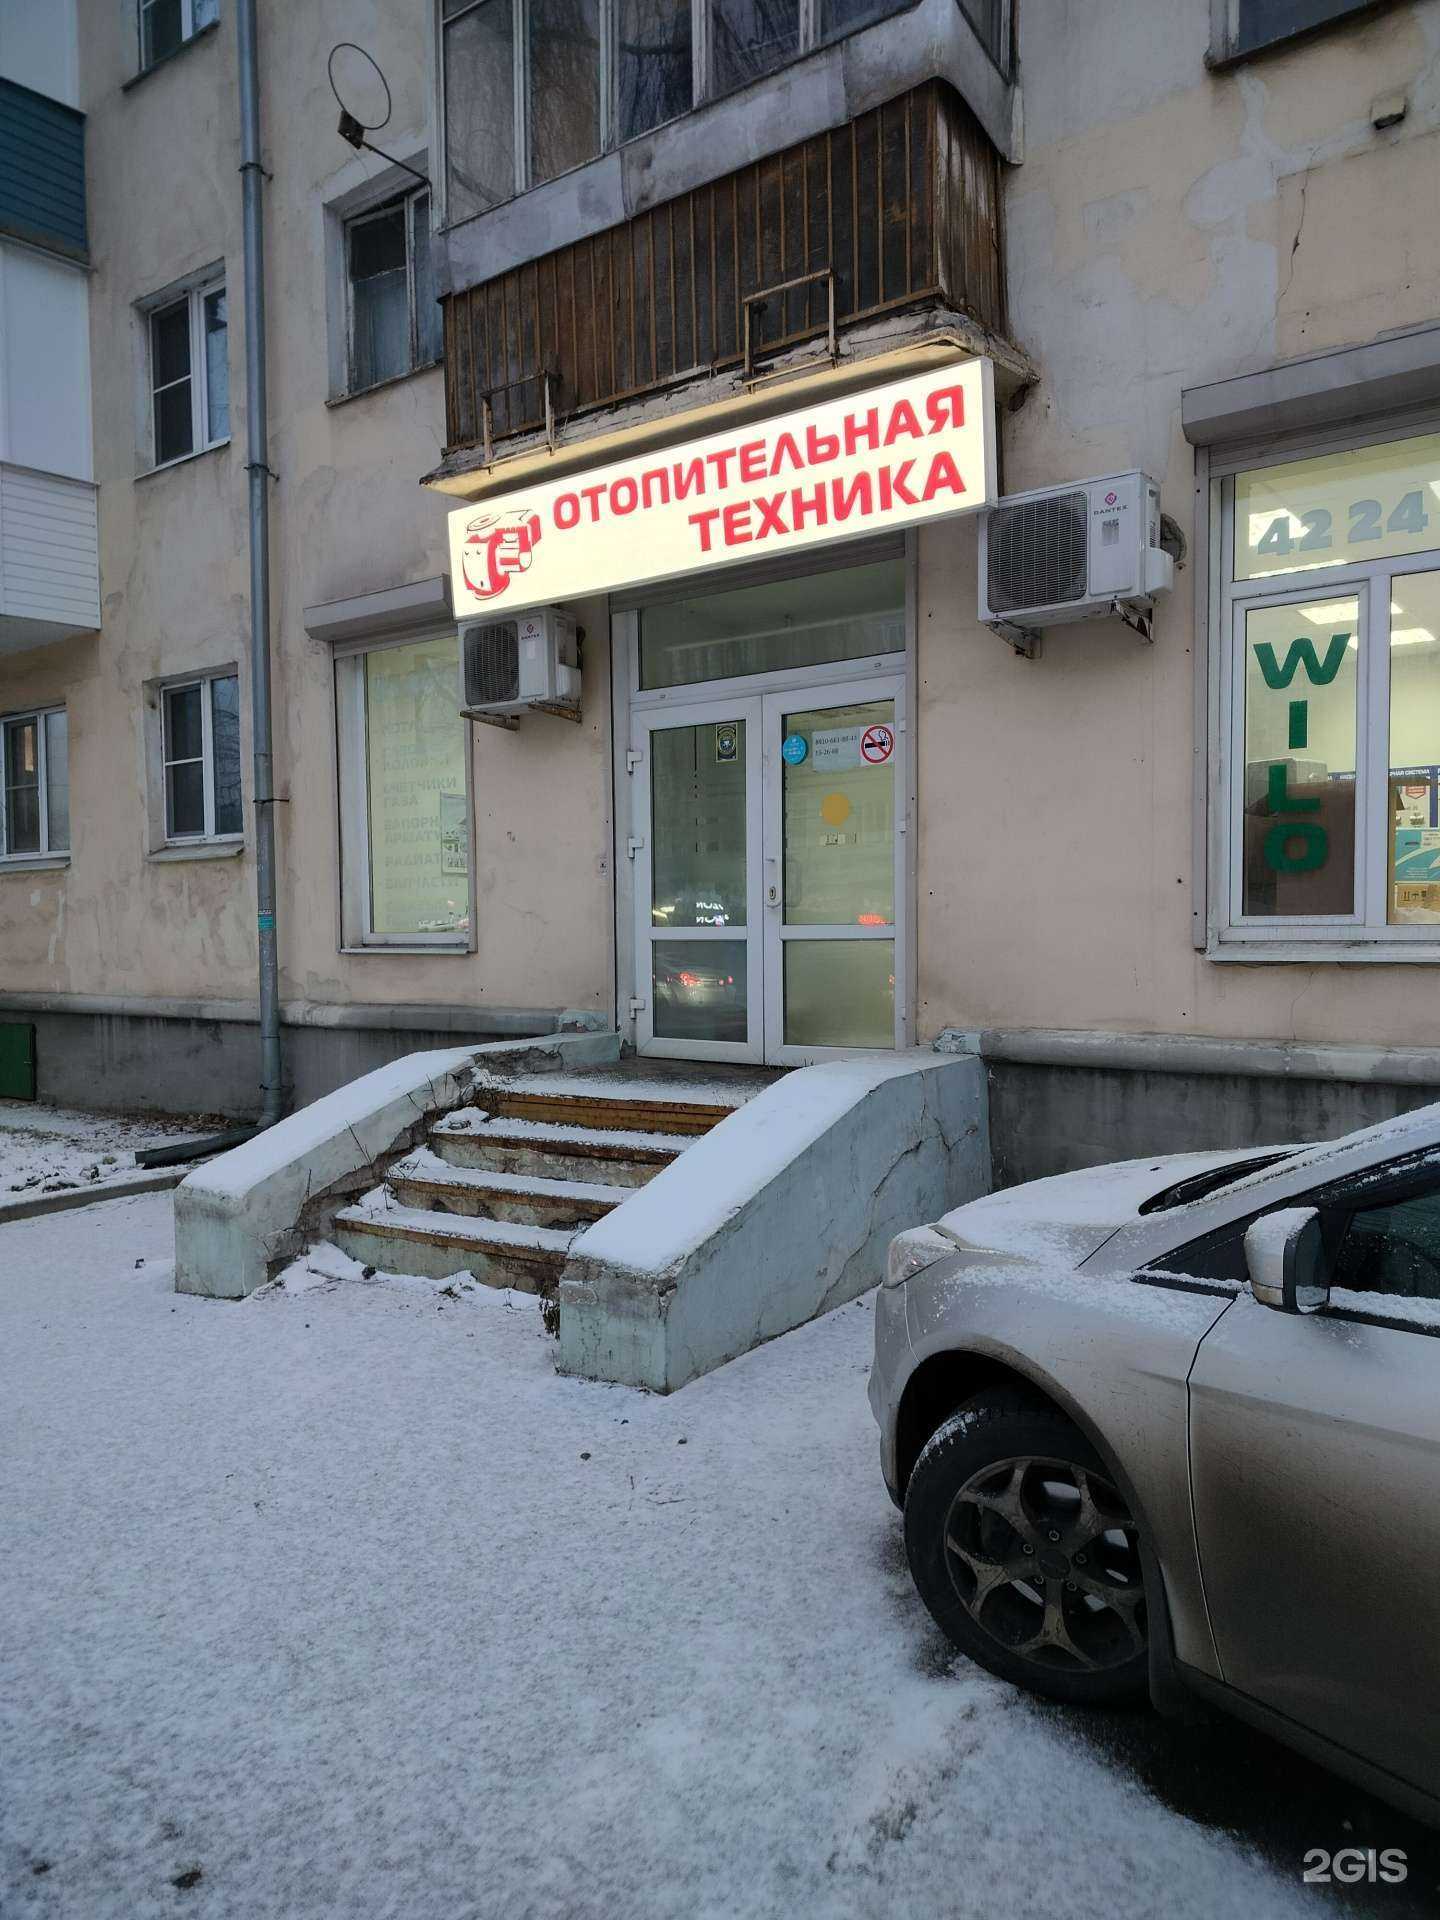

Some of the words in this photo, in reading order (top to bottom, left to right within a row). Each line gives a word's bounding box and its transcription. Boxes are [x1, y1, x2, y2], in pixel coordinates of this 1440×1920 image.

[553, 384, 965, 530] ОТОПИТЕЛЬНАЯ
[688, 451, 966, 553] ТЕХНИКА
[1257, 508, 1332, 555] 42
